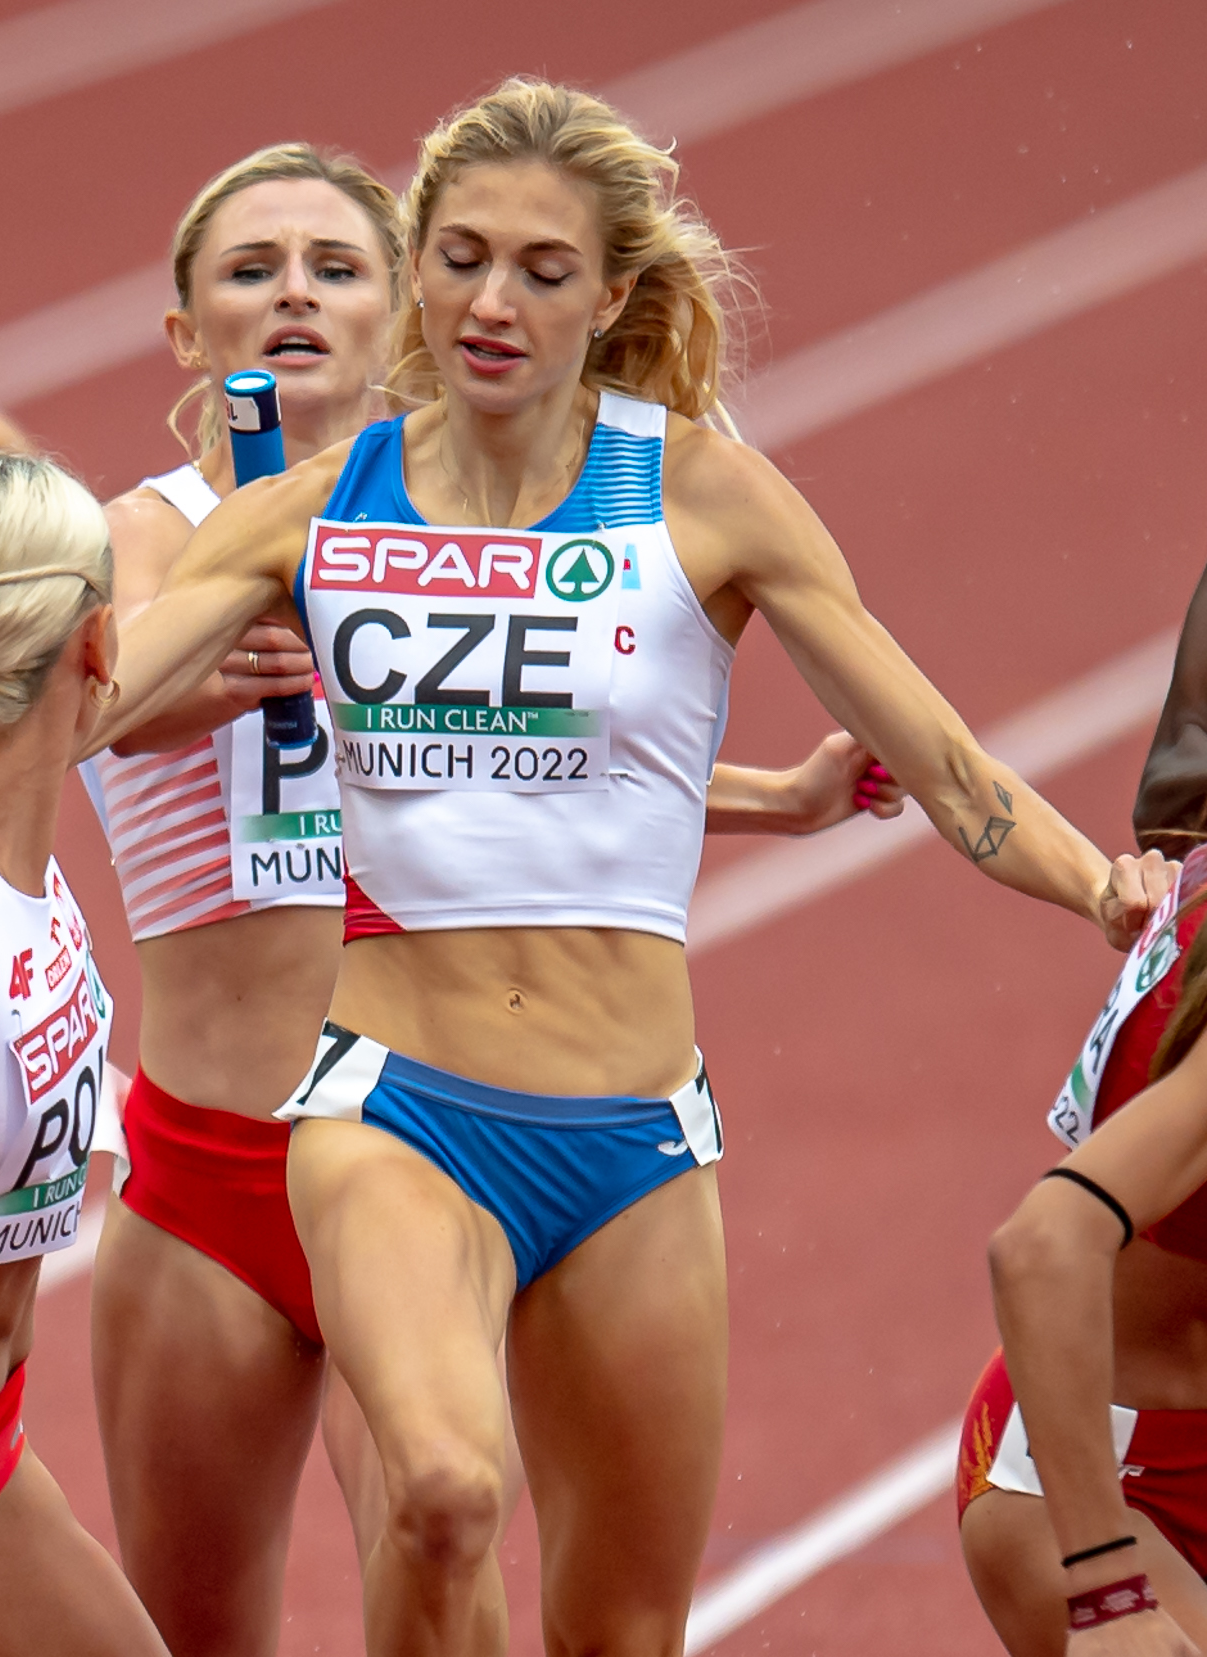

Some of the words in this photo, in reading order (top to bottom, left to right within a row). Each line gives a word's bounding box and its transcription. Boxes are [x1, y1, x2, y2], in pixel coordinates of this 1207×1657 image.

[317, 535, 534, 590] SPAR
[332, 608, 579, 708] CZE
[614, 625, 636, 655] C
[366, 707, 373, 730] I
[380, 707, 436, 731] RUN
[263, 715, 329, 815] P
[342, 738, 474, 779] MUNICH
[490, 745, 589, 781] 2022
[299, 815, 306, 836] I
[21, 980, 95, 1091] SPAR
[294, 1020, 361, 1106] 7
[33, 1187, 41, 1209] I
[44, 1173, 78, 1205] RUN
